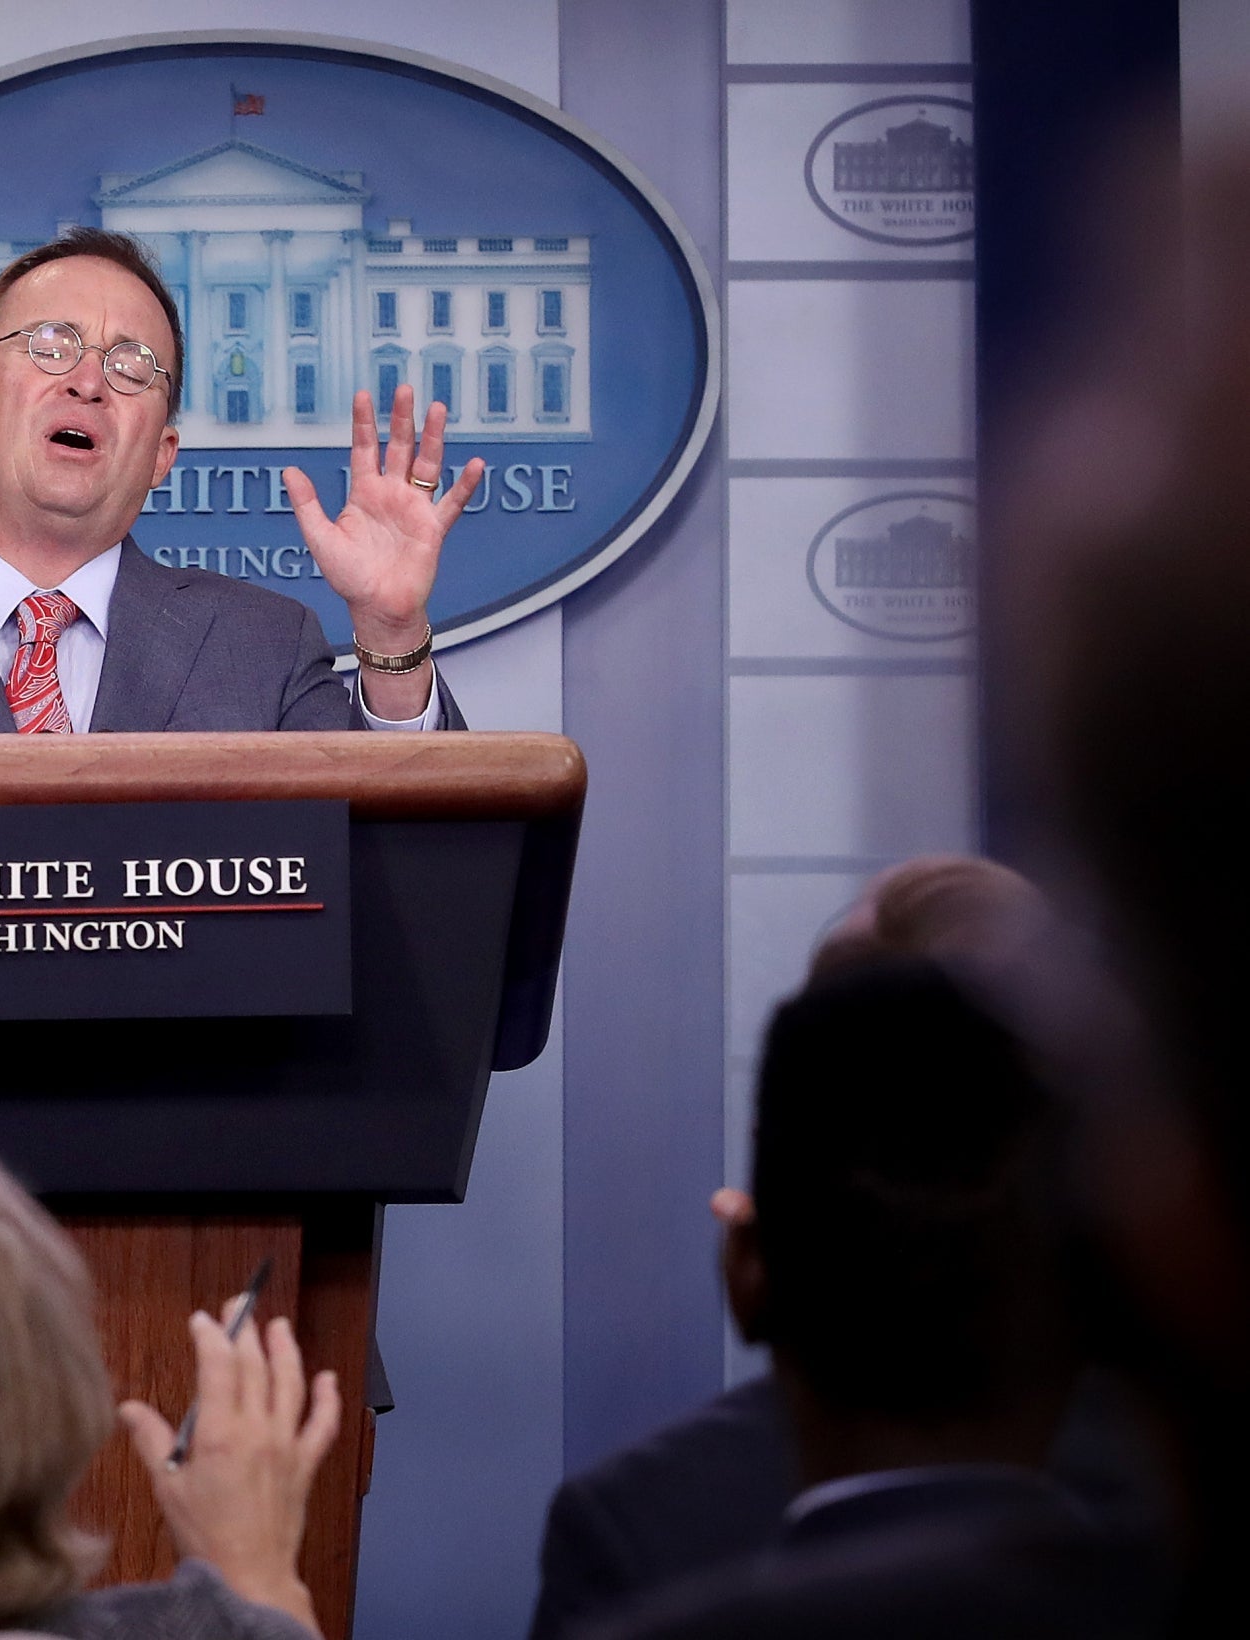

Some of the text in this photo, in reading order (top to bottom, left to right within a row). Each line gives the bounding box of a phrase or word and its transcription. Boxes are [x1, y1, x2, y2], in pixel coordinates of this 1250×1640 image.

[842, 198, 874, 213] THE
[879, 198, 936, 213] WHITE
[122, 856, 308, 897] HOUSE
